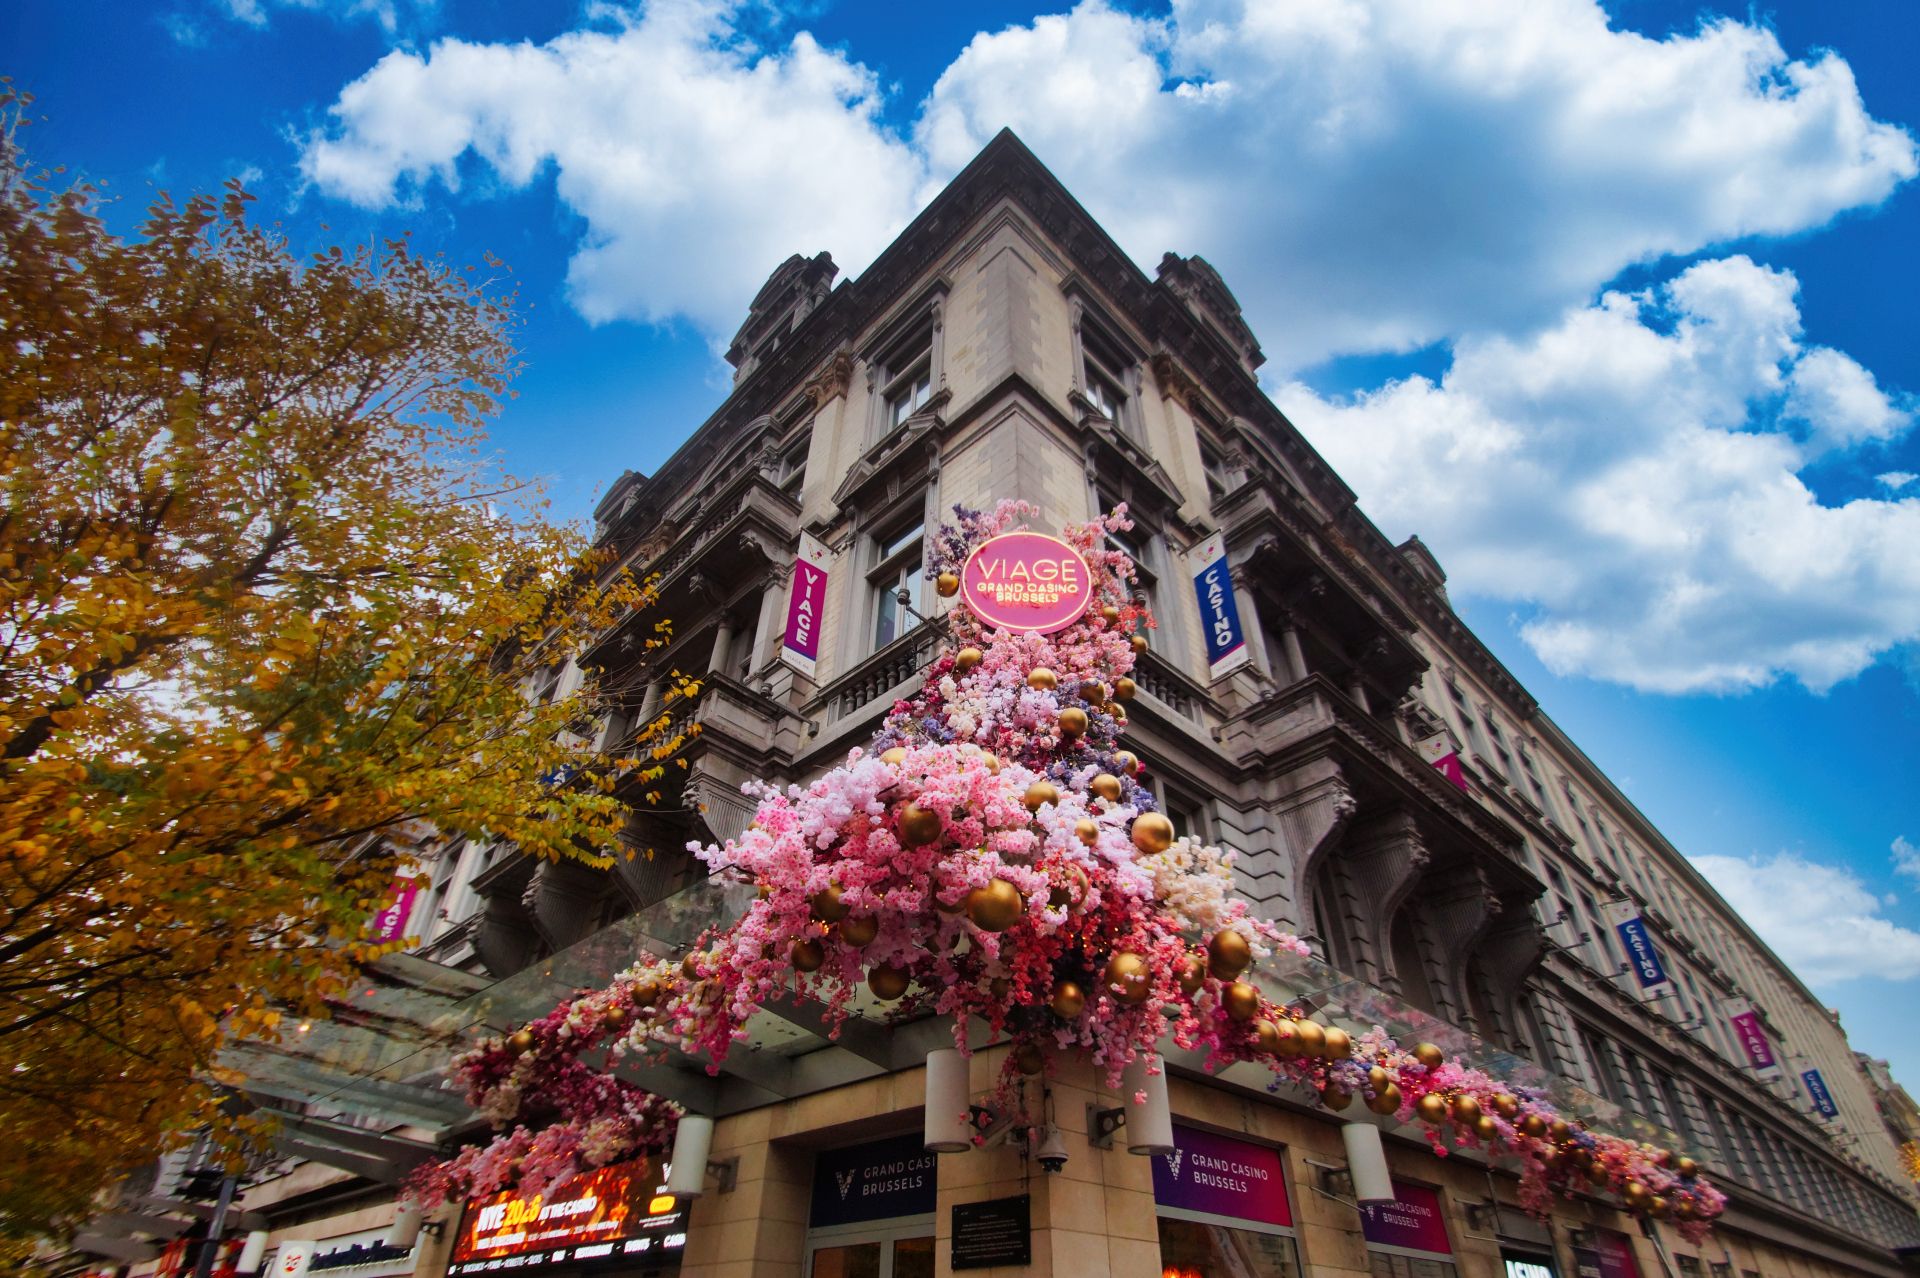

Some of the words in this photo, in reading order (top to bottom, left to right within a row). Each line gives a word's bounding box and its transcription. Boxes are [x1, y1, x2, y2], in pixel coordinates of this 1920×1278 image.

[978, 558, 1077, 582] VIAGE
[977, 582, 1023, 593] GRAND
[1027, 583, 1078, 593] CASINO
[996, 592, 1059, 603] BRUSSELS
[796, 567, 818, 647] VIAGE
[1205, 569, 1232, 647] CASINO
[1625, 924, 1657, 979] CASINO
[1738, 1018, 1766, 1063] VIAGE
[1807, 1074, 1831, 1113] CASINO
[864, 1162, 904, 1179] GRAND
[1191, 1154, 1229, 1172] GRAND
[1231, 1162, 1268, 1180] CASINO
[862, 1176, 923, 1196] BRUSSELS
[1193, 1171, 1248, 1193] BRUSSELS
[477, 1203, 508, 1232] NYE
[538, 1205, 551, 1221] AT
[550, 1202, 566, 1219] THE
[564, 1196, 597, 1217] CASINO
[1382, 1212, 1421, 1228] BRUSSELS
[1405, 1204, 1433, 1217] CASINO
[624, 1238, 651, 1253] EVENTS
